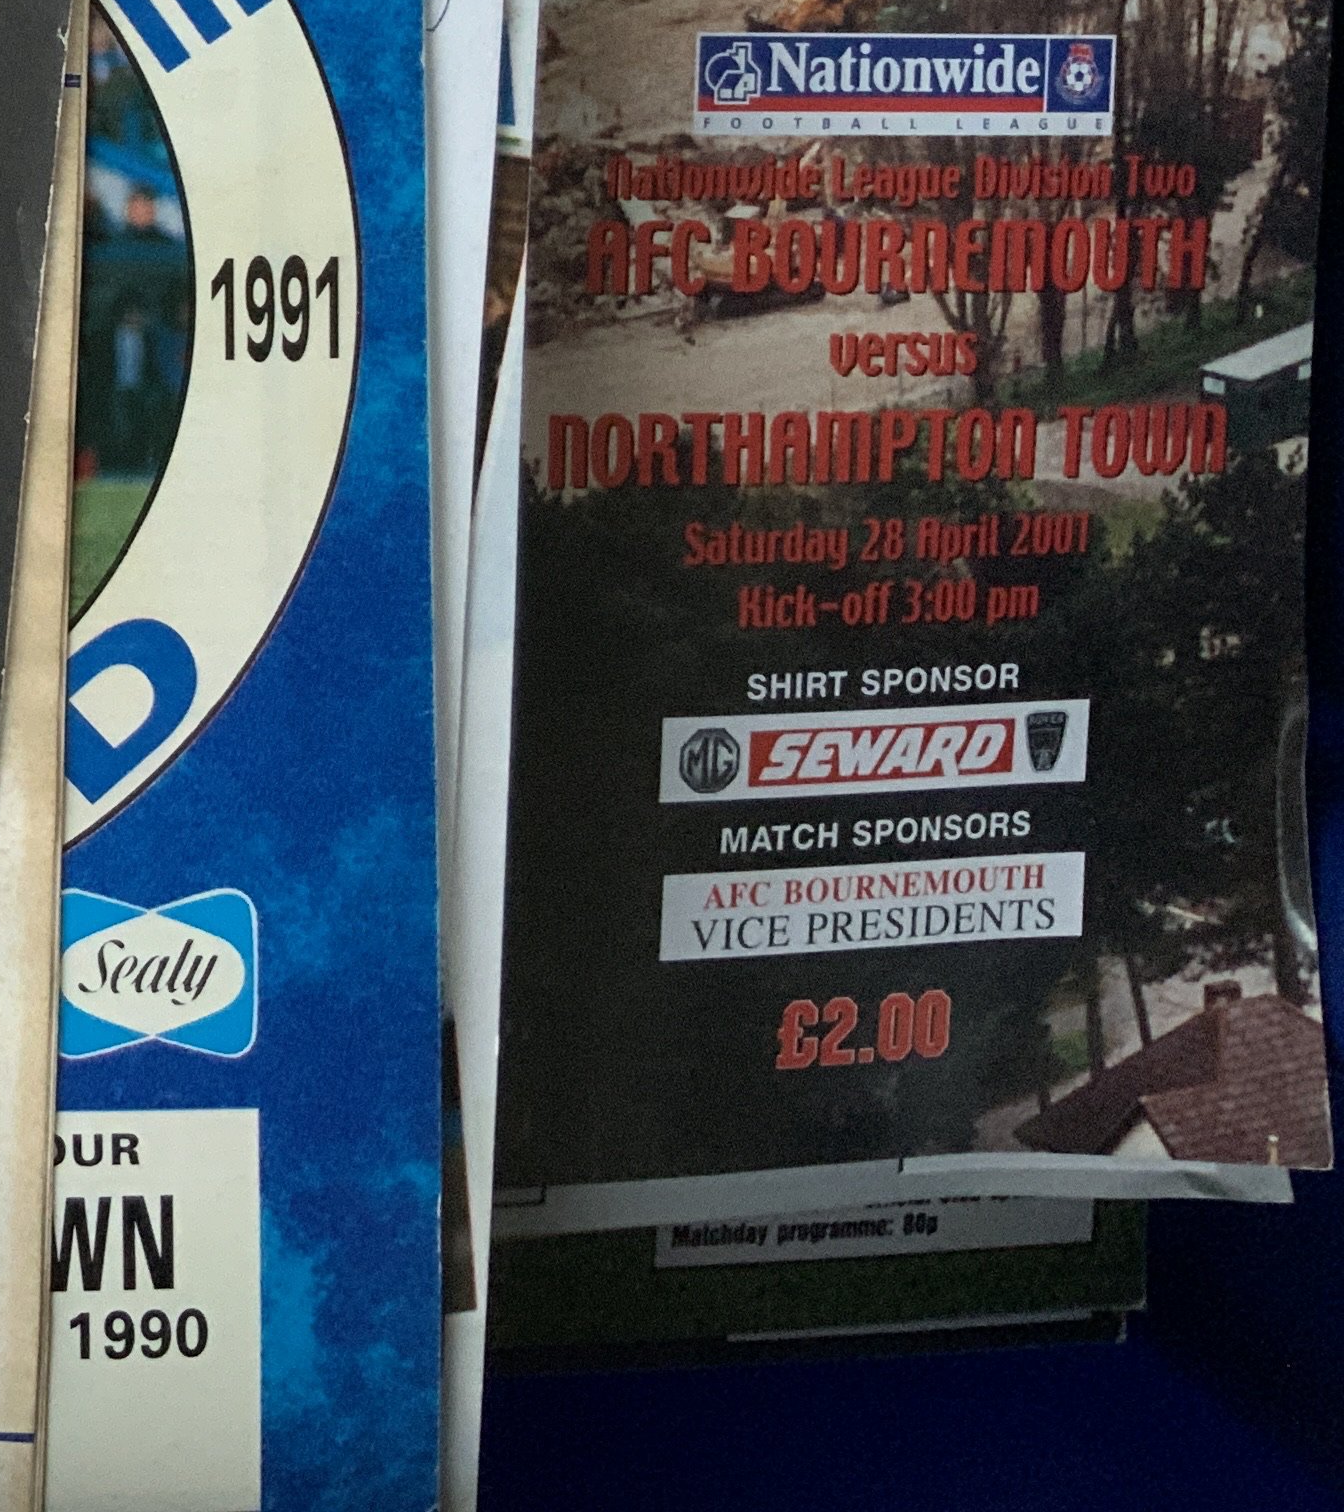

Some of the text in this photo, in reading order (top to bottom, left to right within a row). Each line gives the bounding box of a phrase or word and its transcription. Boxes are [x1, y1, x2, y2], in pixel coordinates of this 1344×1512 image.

[767, 40, 1042, 94] Nationwide
[703, 116, 1103, 131] FOOTBALL LEAGUE
[831, 155, 962, 207] League
[974, 154, 1111, 202] Division
[1123, 153, 1197, 198] Two
[586, 217, 1213, 297] AFC BOURNEMOUTH
[211, 254, 340, 363] 1991
[829, 331, 979, 377] versus
[546, 401, 1228, 488] NORTHAMPTON TOWN
[682, 510, 1090, 569] Saturday 28 April 2001
[738, 581, 1041, 630] Kick-off 3:00 pm
[747, 662, 1020, 701] SHIRT SPONSOR
[683, 723, 1009, 781] MG SEWARD
[720, 810, 1032, 855] MATCH SPONSORS
[703, 863, 1046, 911] AFC BOURNEMOUTH
[691, 897, 1057, 951] VICE PRESIDENTS
[78, 938, 218, 1006] Sealy
[775, 989, 953, 1070] £2.00
[671, 1222, 769, 1248] Matchday
[69, 1307, 209, 1360] 1990
